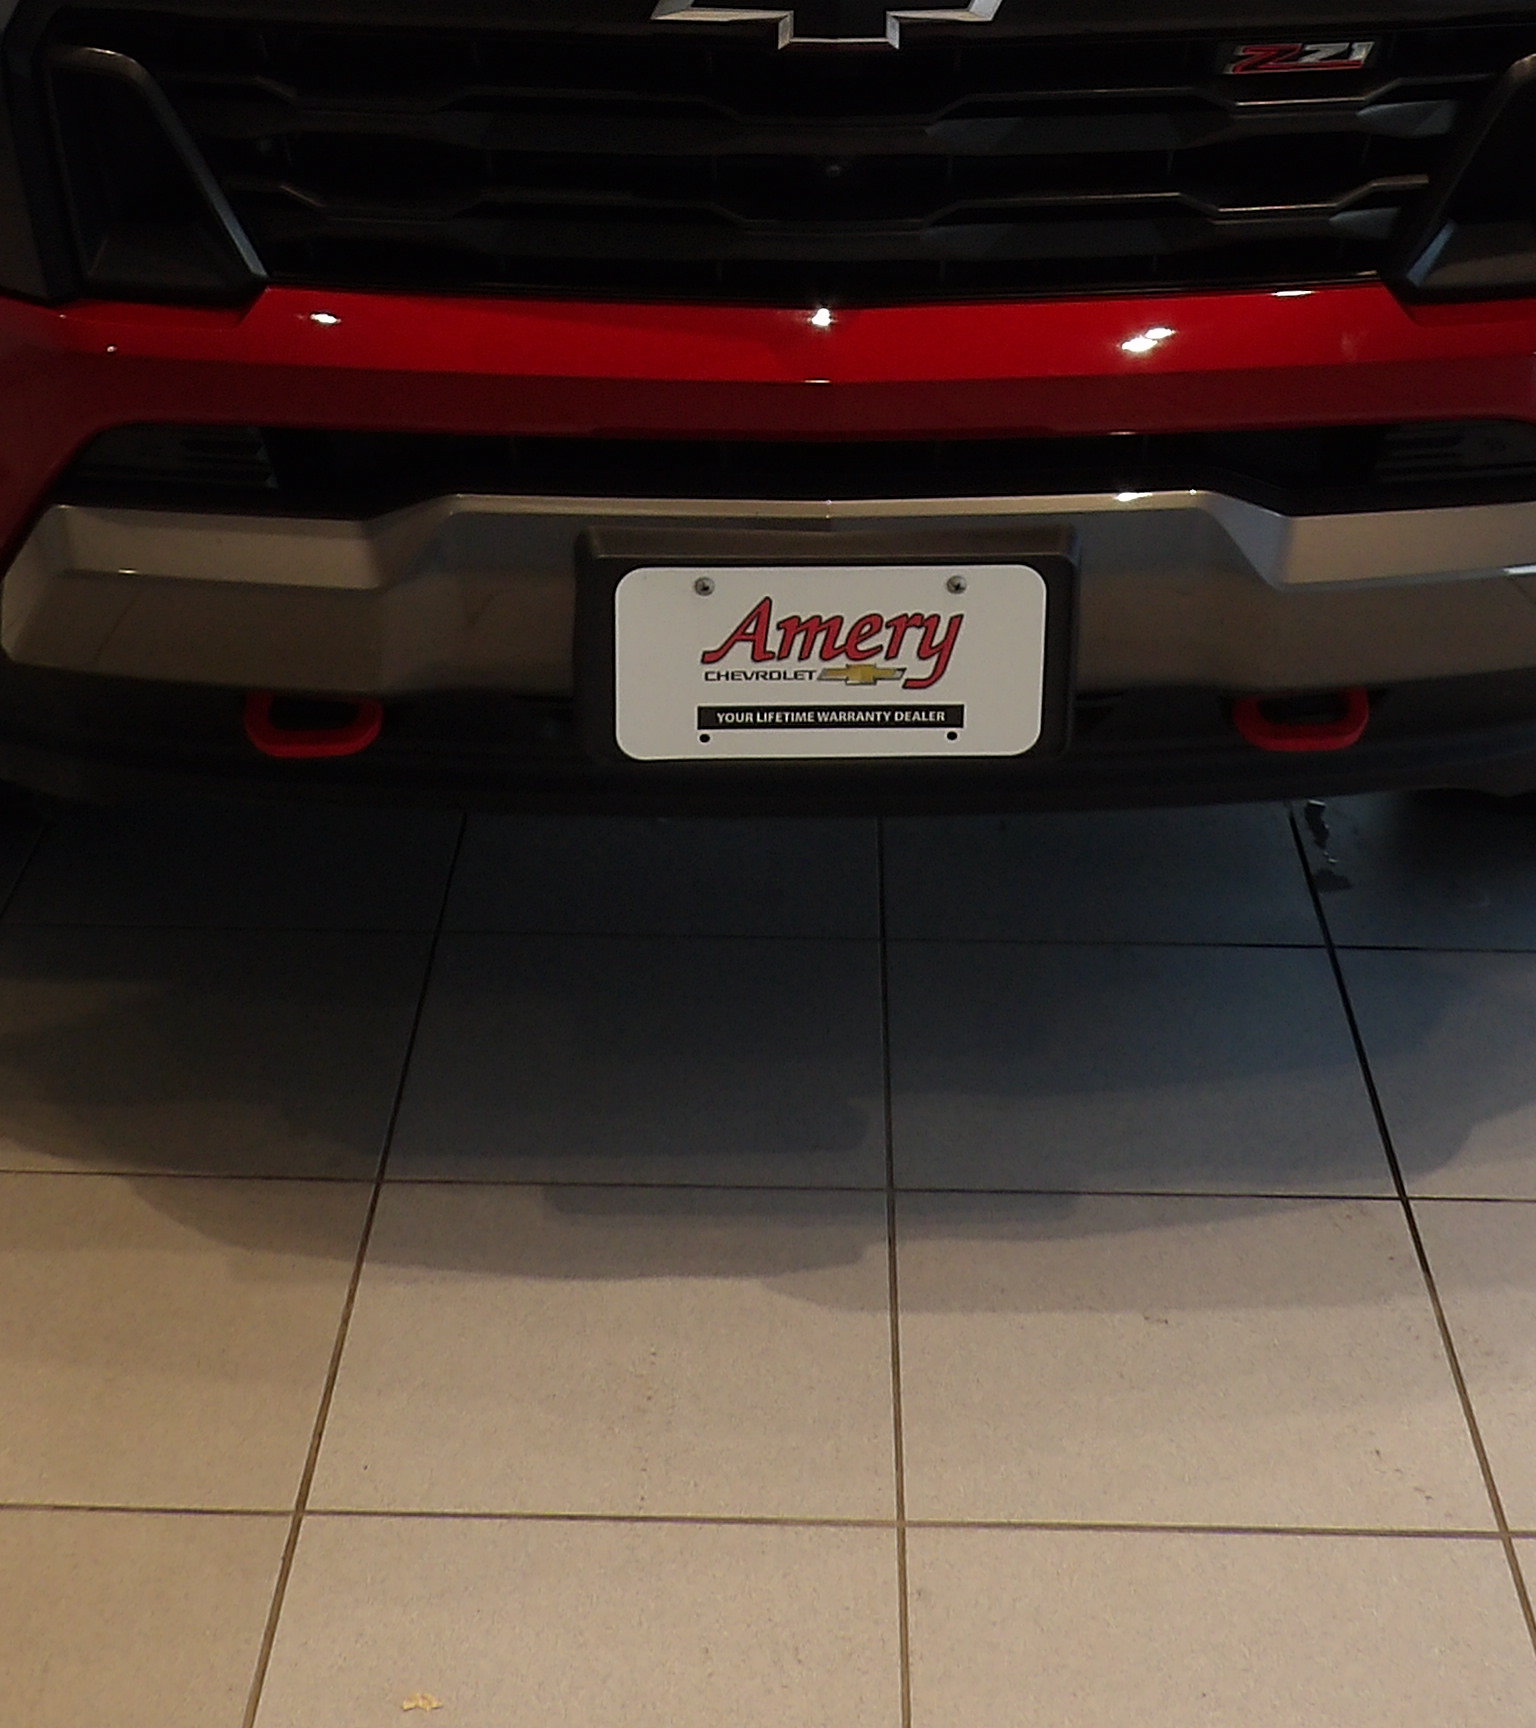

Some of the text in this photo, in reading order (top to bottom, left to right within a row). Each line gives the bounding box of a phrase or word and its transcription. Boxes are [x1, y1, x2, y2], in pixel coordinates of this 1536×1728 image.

[1223, 41, 1375, 74] Z71
[700, 595, 964, 690] Amery
[704, 669, 817, 682] CHEVROLET
[716, 710, 946, 724] YOUR LIFETIME WARRANTY DEALER
